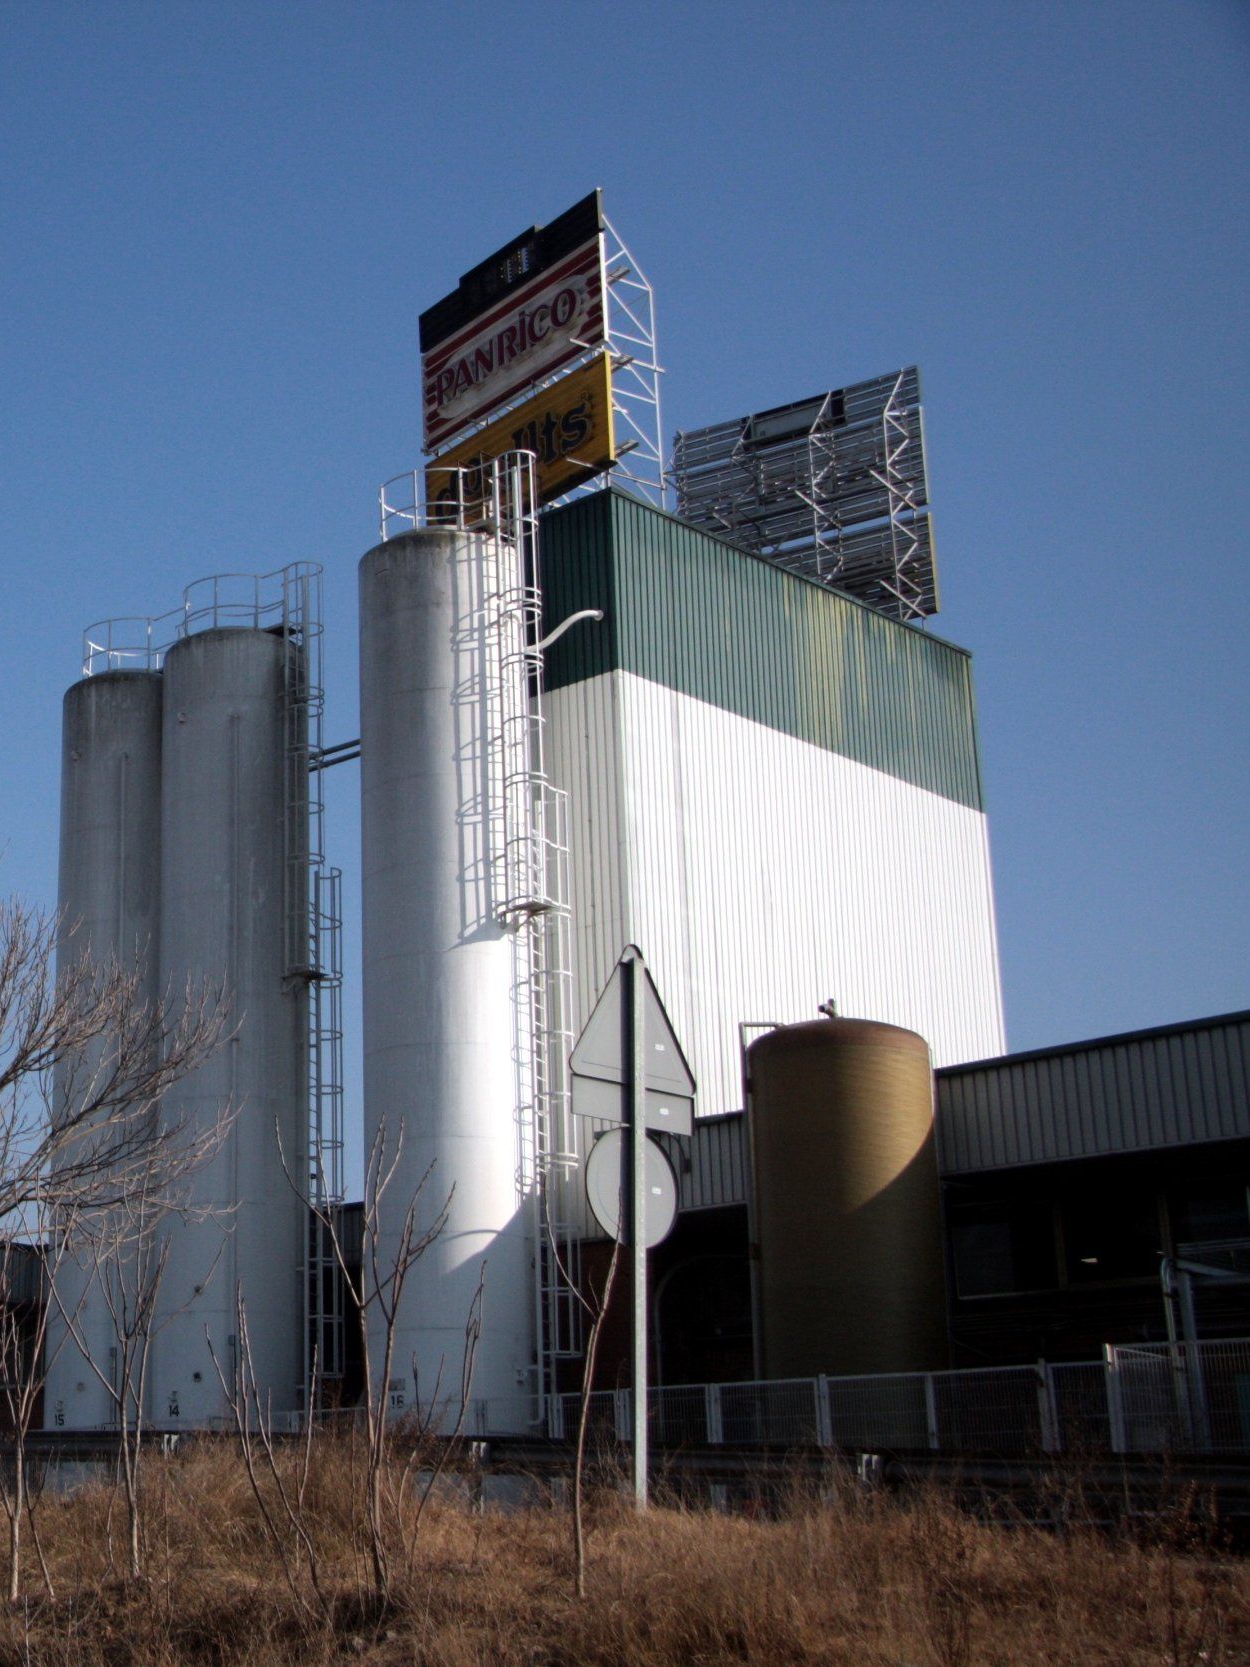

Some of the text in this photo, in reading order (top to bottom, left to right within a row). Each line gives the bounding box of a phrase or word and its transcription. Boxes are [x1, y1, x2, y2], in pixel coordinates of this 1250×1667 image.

[434, 402, 592, 525] douts
[391, 1394, 405, 1409] 16
[169, 1404, 180, 1417] 14
[54, 1413, 65, 1426] 15
